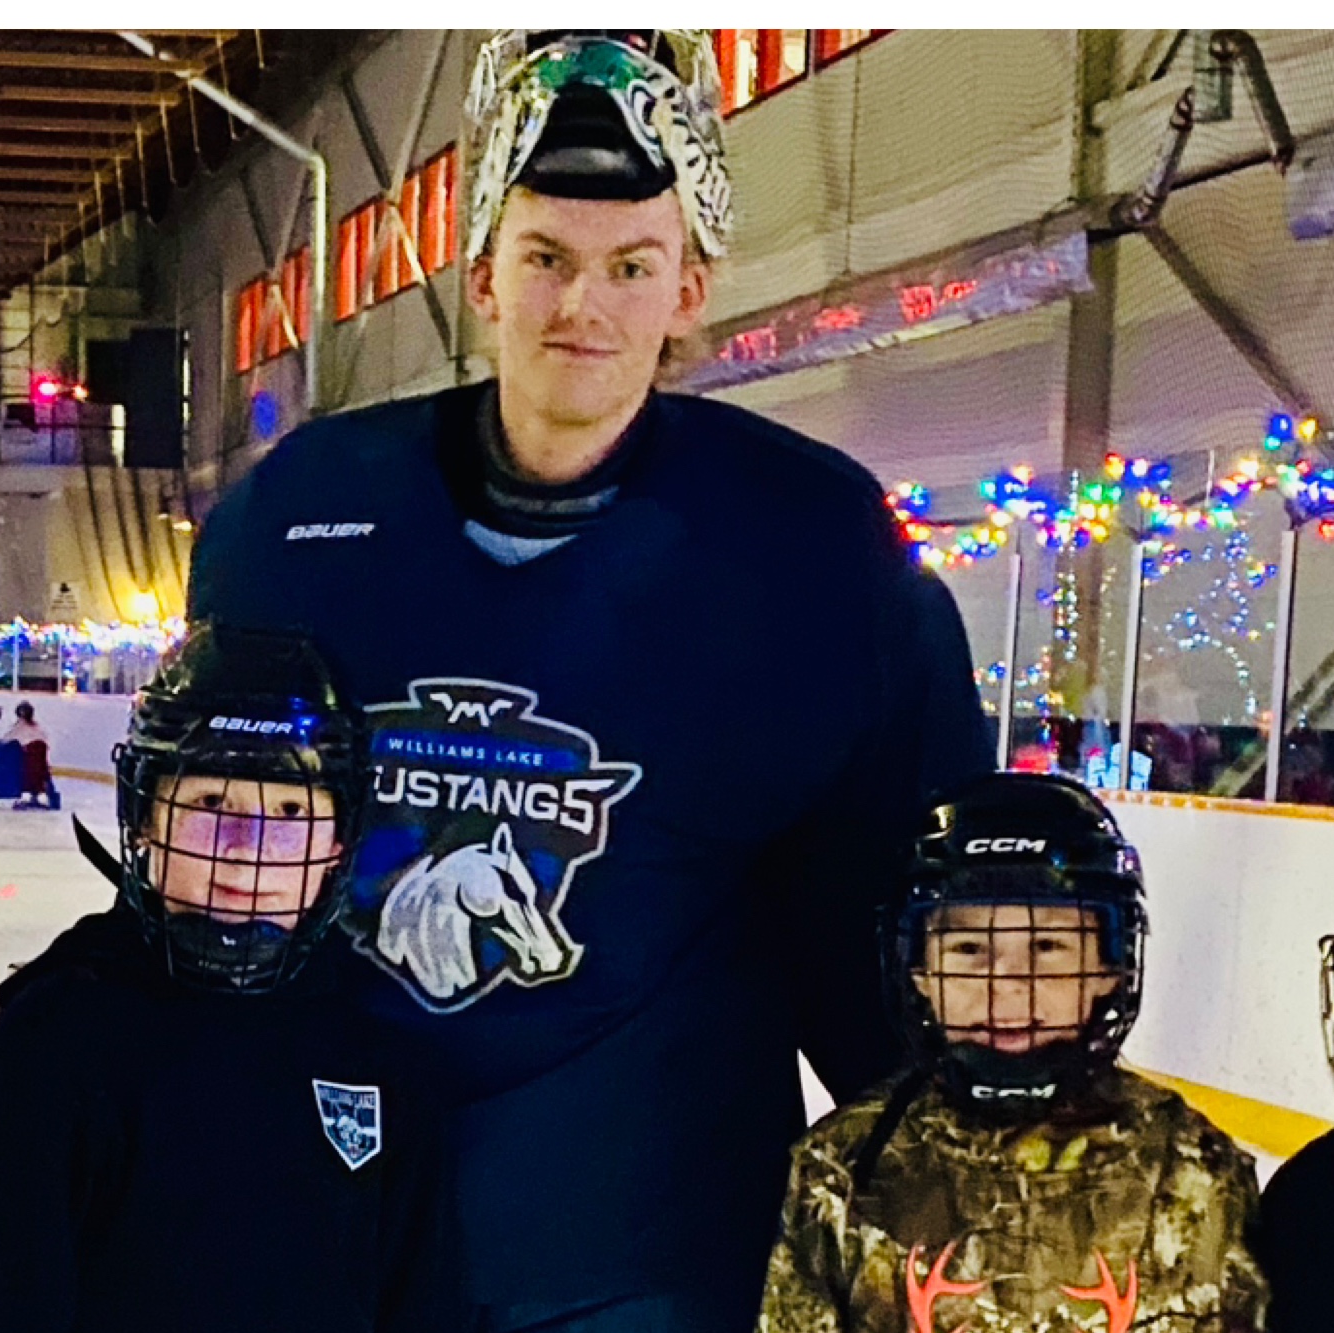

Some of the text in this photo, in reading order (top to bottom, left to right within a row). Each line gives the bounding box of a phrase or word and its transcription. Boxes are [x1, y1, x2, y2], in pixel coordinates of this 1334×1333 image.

[388, 738, 544, 767] WILLIAMS LAKE
[373, 764, 616, 836] USTANGS
[965, 838, 1048, 854] CCM
